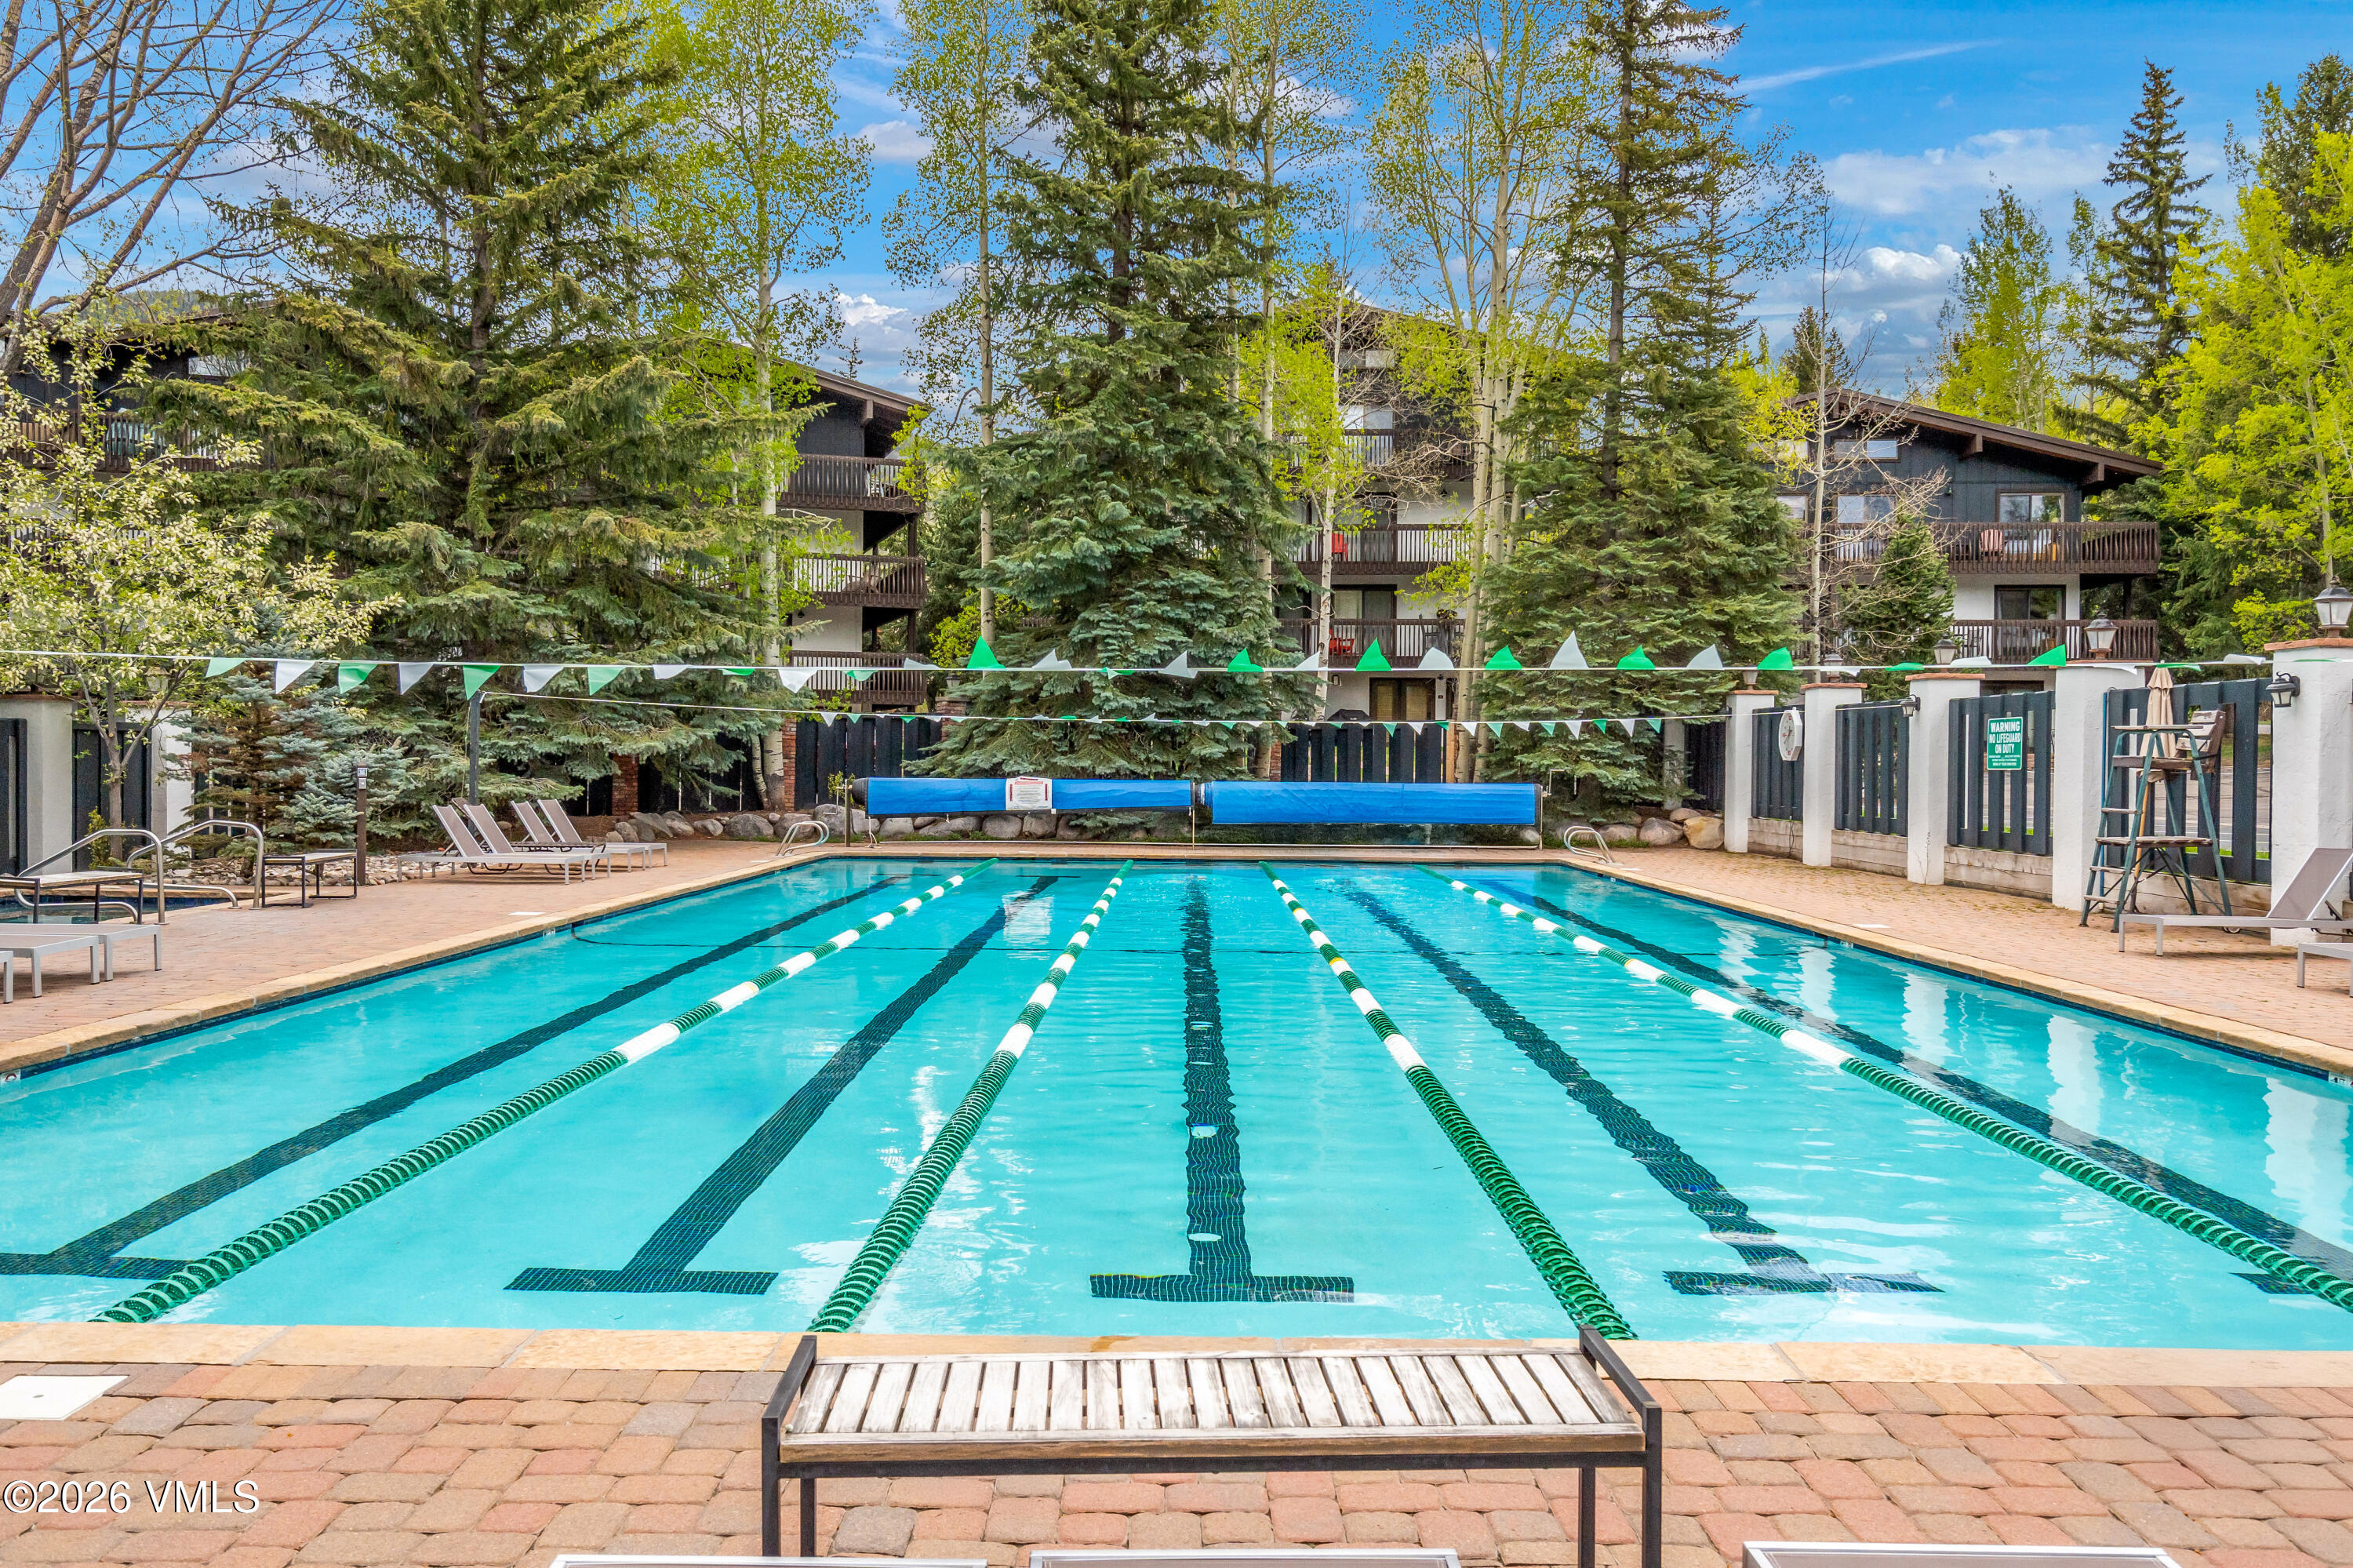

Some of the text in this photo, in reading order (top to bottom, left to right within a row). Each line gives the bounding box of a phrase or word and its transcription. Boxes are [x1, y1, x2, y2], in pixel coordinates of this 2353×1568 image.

[1991, 721, 2020, 733] WARNING
[1989, 733, 2021, 744] NO LIFEGUARD
[1995, 743, 2015, 754] ON DUTY
